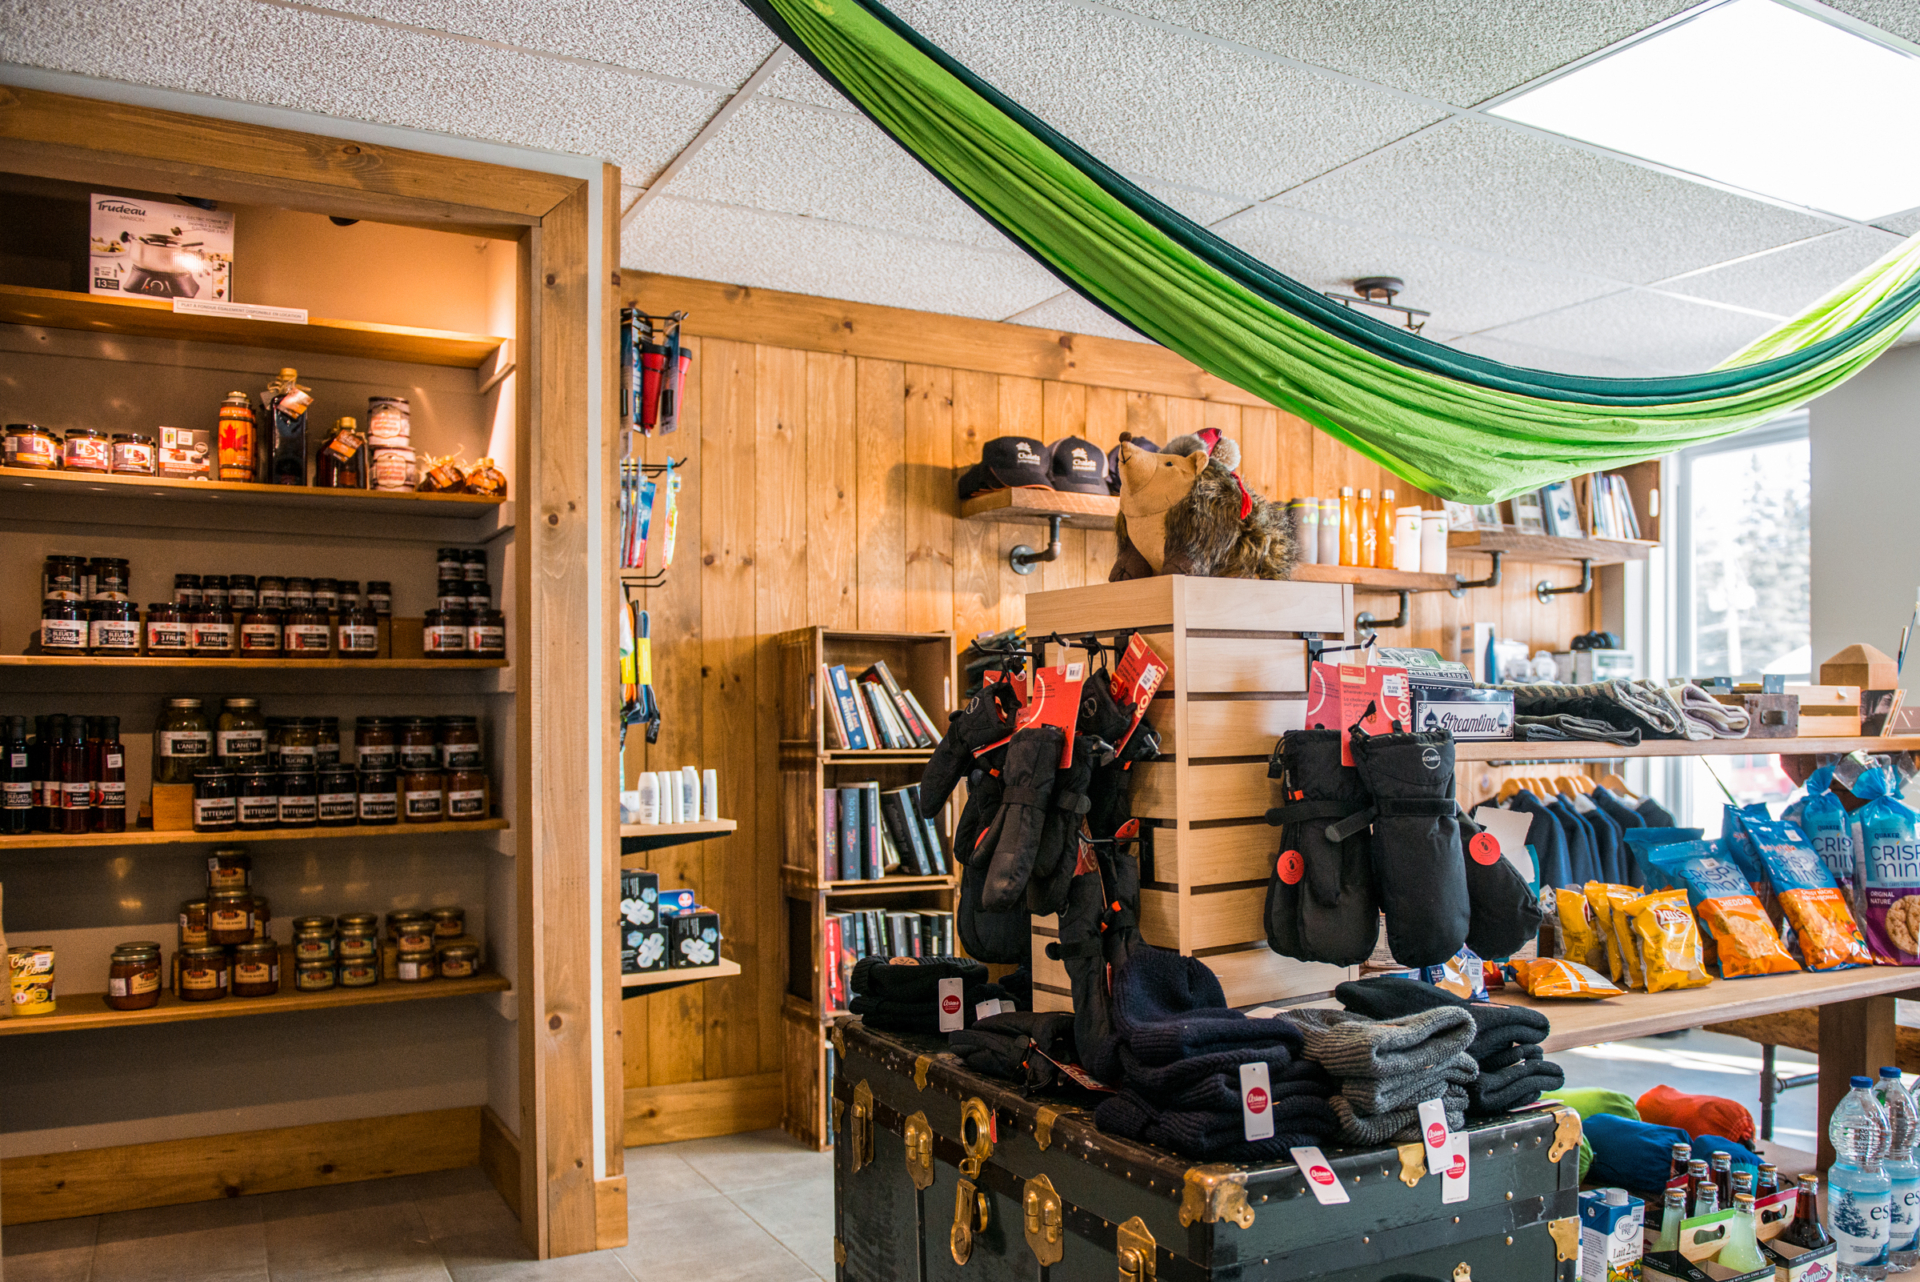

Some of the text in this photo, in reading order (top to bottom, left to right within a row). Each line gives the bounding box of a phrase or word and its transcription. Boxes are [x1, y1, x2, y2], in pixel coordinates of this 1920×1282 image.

[97, 200, 146, 216] Trudeau
[96, 279, 107, 288] 13
[1134, 664, 1165, 719] KOMBI
[1396, 673, 1410, 725] KOMBI
[1440, 711, 1497, 733] Streamline
[1771, 854, 1819, 868] CRISPY
[1678, 865, 1744, 883] CRISPY
[1783, 868, 1828, 882] minis
[1694, 876, 1751, 892] minis
[1870, 890, 1895, 898] ORIGINAL
[1870, 897, 1892, 905] NATURE
[1718, 897, 1752, 907] CHEDDAR
[1656, 908, 1689, 924] Lay's
[1612, 1246, 1626, 1259] Lait
